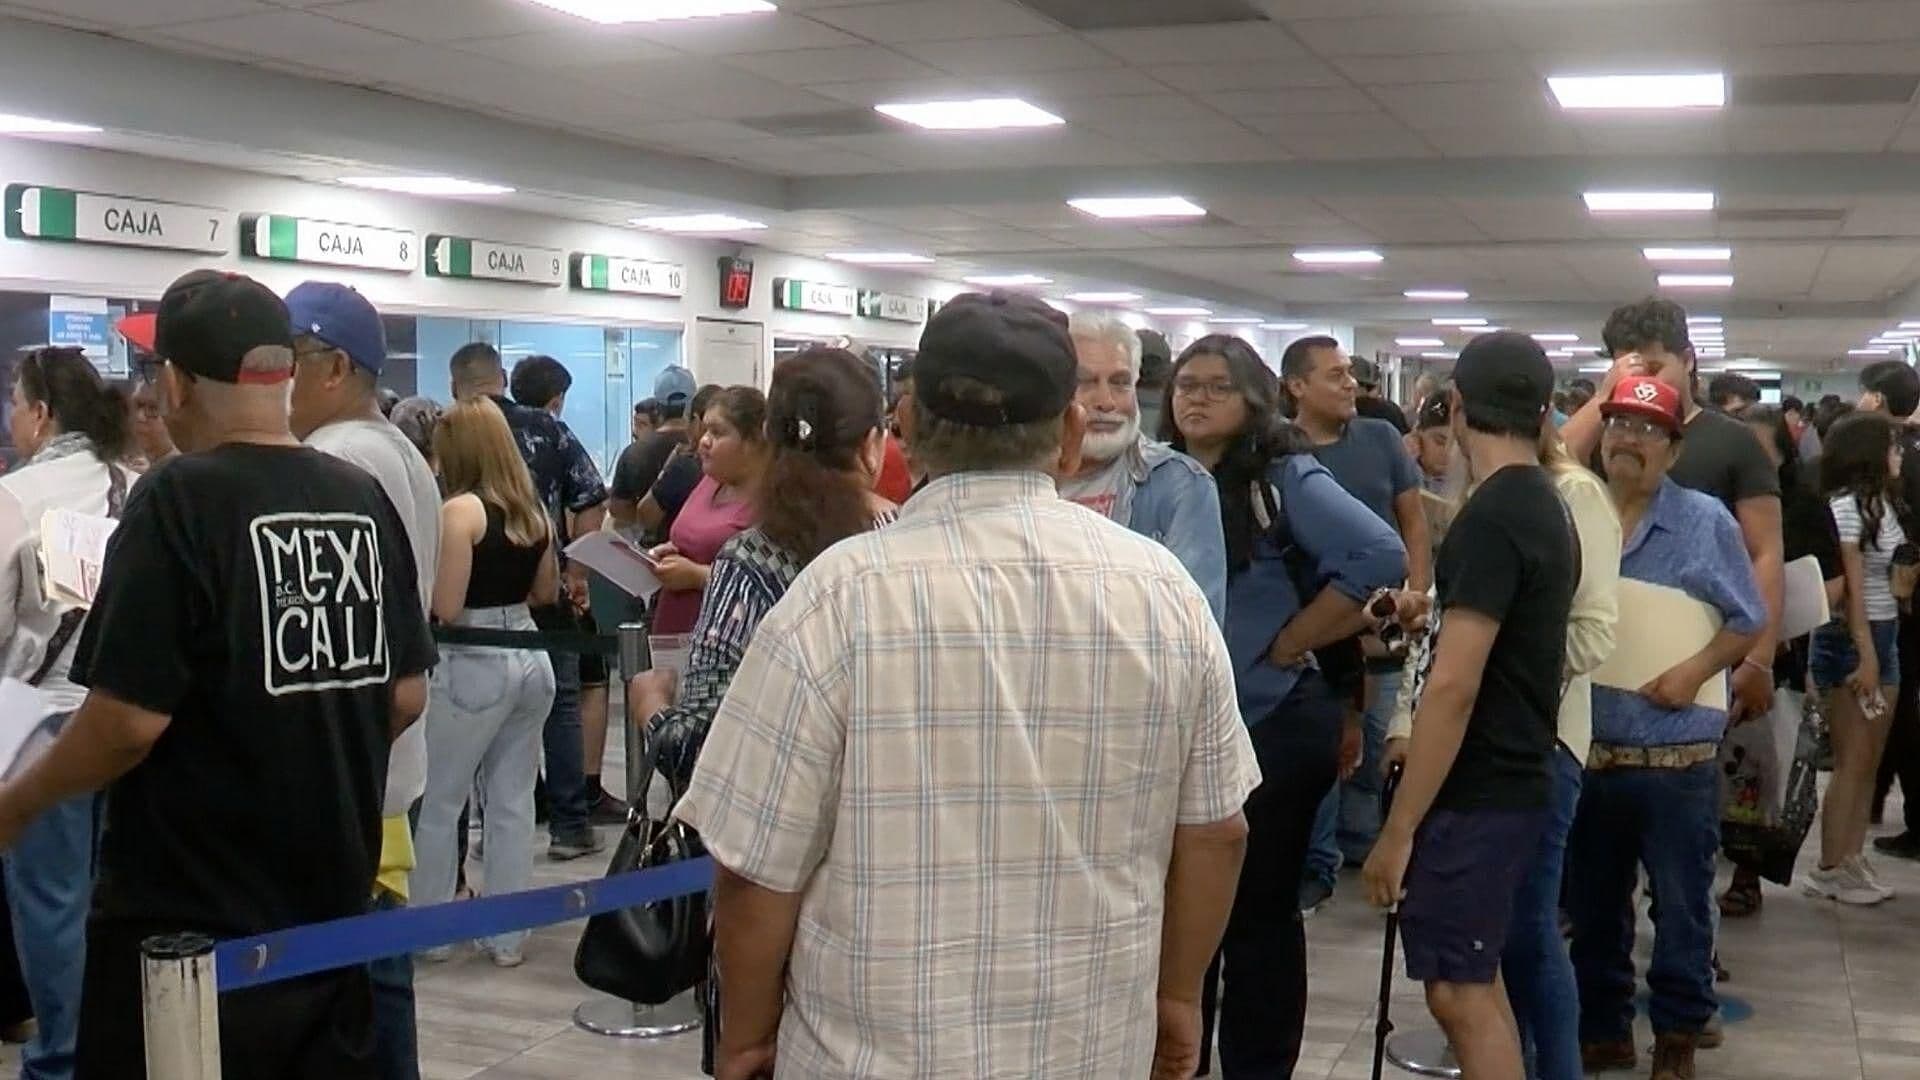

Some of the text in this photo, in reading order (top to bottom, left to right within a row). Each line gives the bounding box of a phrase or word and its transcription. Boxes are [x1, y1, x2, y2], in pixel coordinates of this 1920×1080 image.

[104, 207, 219, 241] CAJA 7
[319, 232, 408, 261] CAJA 8
[487, 250, 560, 276] CAJA 9
[621, 266, 681, 289] CAJA 10
[261, 526, 379, 604] MEXI
[275, 605, 384, 673] CALI
